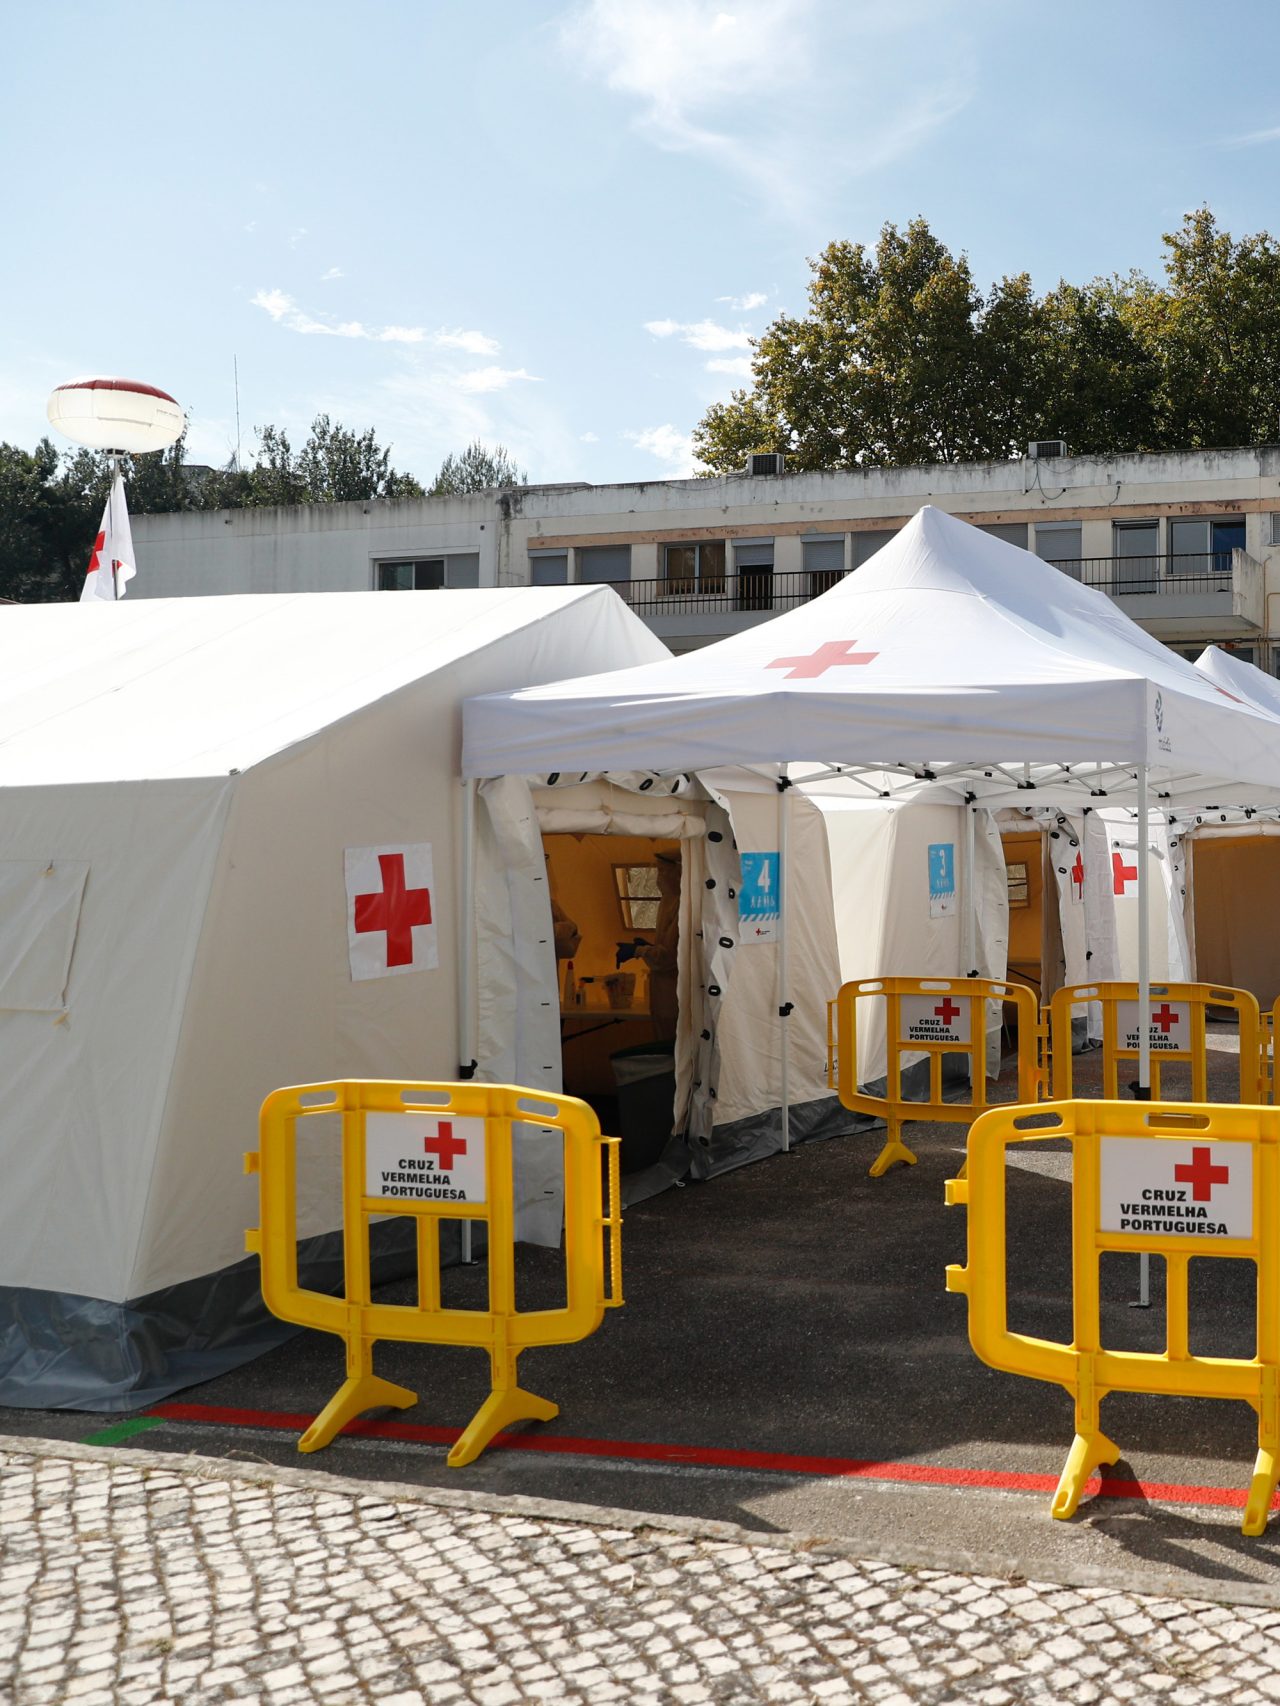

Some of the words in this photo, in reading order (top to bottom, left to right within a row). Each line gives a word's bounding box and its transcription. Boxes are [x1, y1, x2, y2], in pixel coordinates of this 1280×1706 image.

[939, 849, 946, 877] 3
[757, 860, 771, 893] 4
[909, 1026, 950, 1034] VERMELHA
[1127, 1042, 1179, 1050] POUGUESA
[398, 1159, 434, 1170] CRUZ
[381, 1171, 451, 1185] VERMELHA
[382, 1185, 467, 1200] PORTUGUESA
[1142, 1189, 1187, 1202] CRUZ
[1120, 1203, 1208, 1218] VERMELHA
[1120, 1218, 1228, 1235] PORTUGUESA
